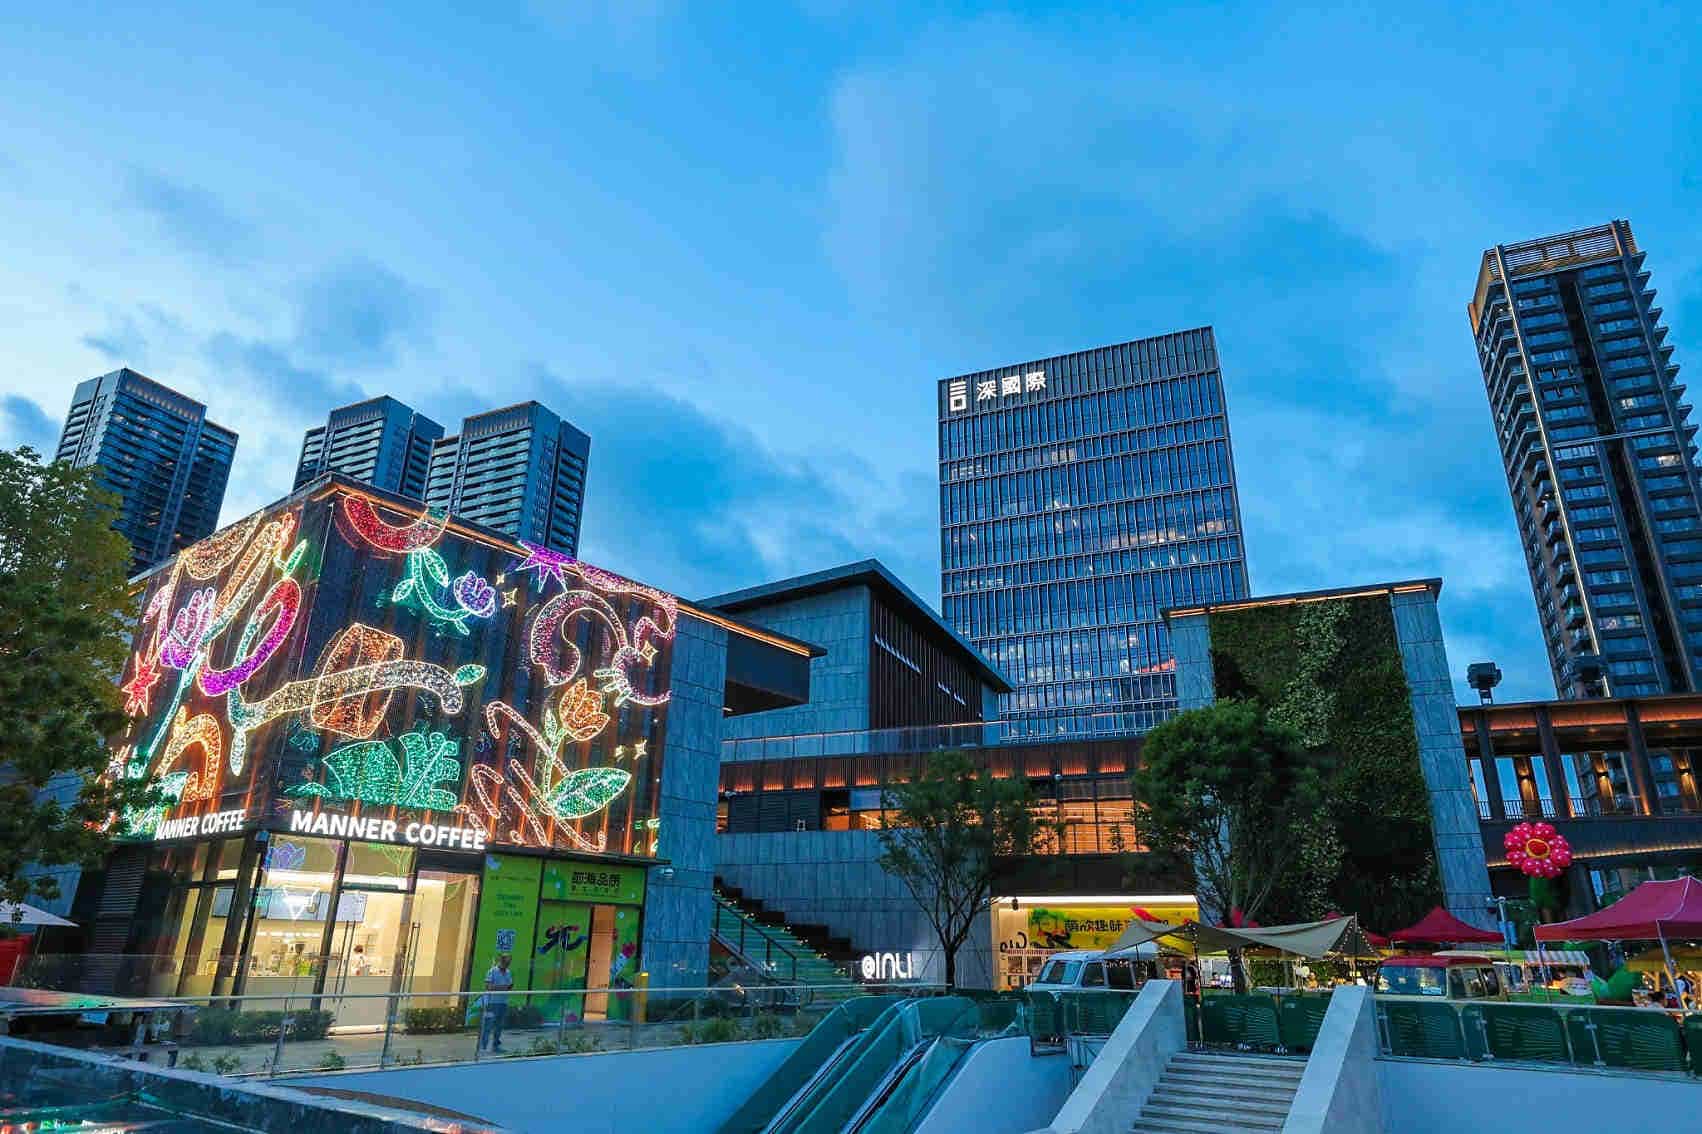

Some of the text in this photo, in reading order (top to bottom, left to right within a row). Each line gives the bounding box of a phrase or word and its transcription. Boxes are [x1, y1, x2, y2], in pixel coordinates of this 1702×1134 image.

[155, 810, 246, 840] MANNER COFFEE
[290, 809, 486, 850] MANNER COFFEE
